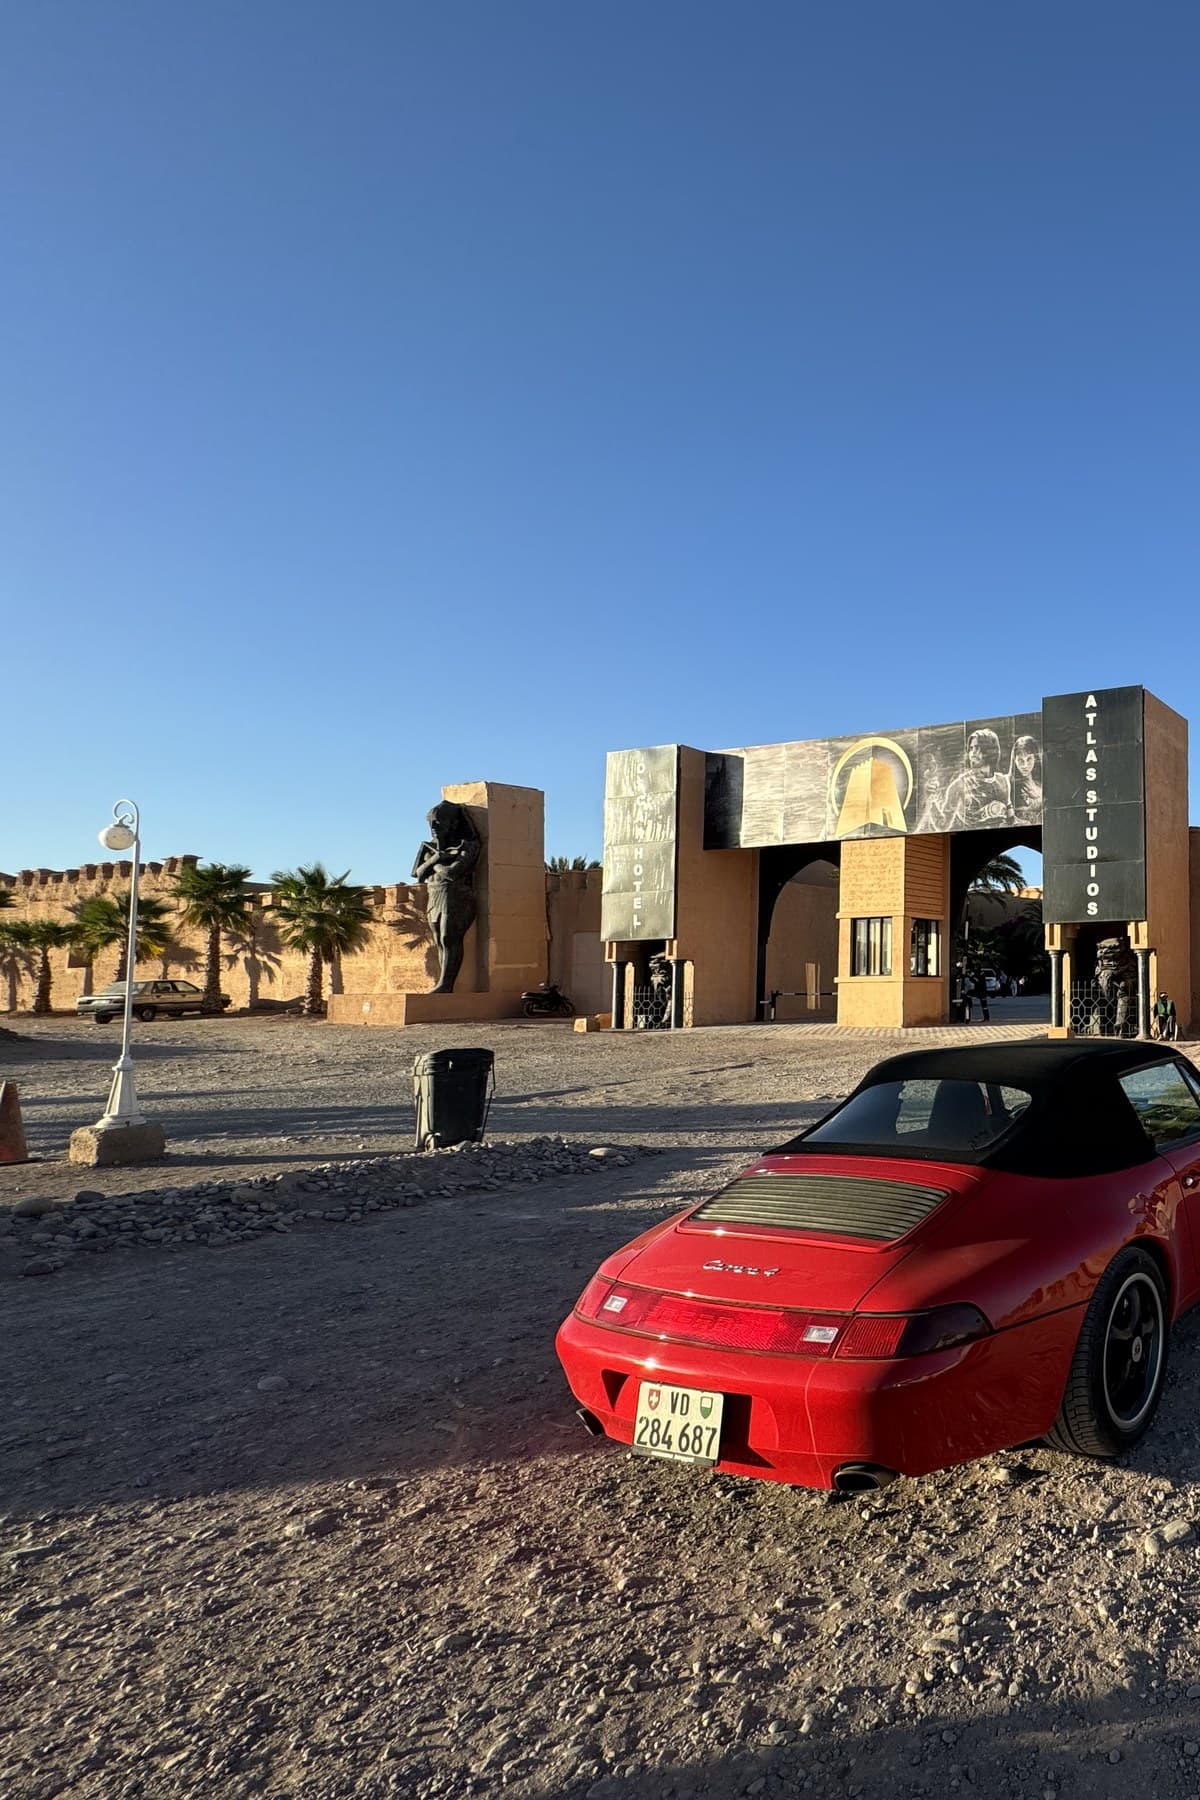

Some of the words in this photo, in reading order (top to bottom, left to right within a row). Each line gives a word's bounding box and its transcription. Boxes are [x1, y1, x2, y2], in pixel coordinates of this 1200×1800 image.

[1085, 694, 1098, 782] ATLAS
[633, 847, 644, 926] HOTEL
[1085, 790, 1099, 916] STUDIOS
[636, 1416, 673, 1450] 284
[678, 1421, 718, 1457] 687
[670, 1391, 690, 1416] VD
